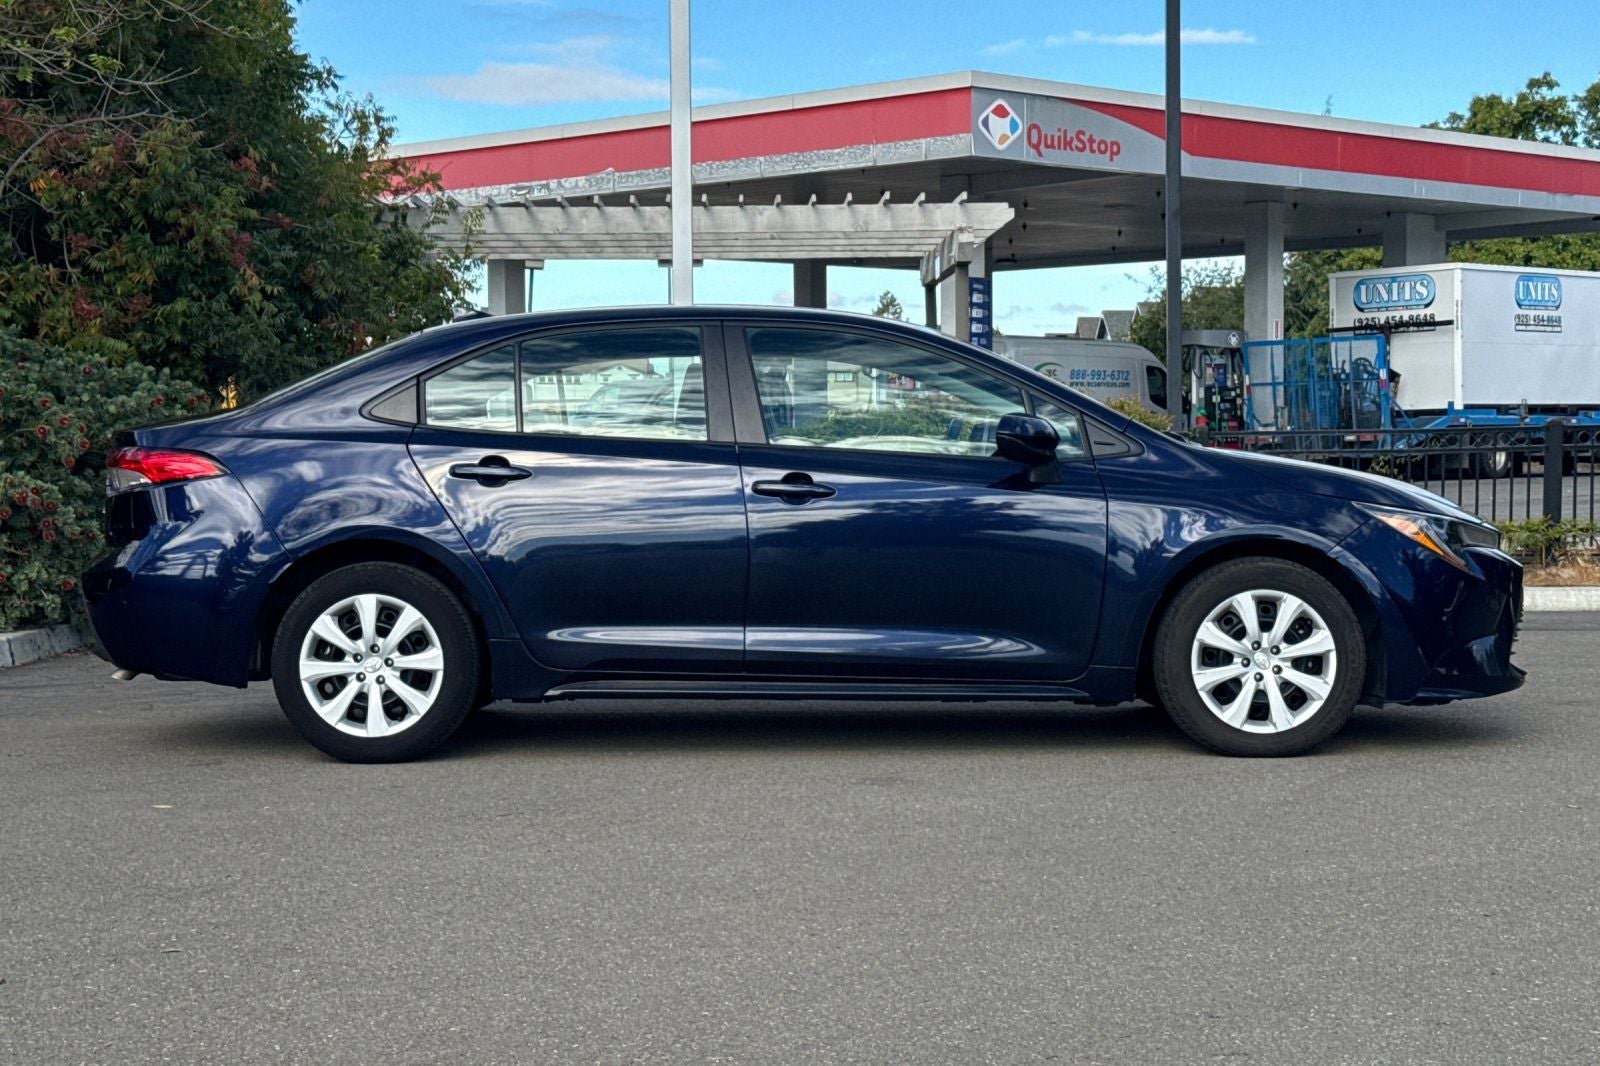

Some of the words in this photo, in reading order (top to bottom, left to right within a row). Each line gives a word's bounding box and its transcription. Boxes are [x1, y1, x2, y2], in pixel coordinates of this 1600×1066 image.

[1026, 122, 1121, 161] QuikStop
[1359, 280, 1429, 305] UNITS
[1518, 281, 1558, 302] UNITS
[1514, 313, 1531, 325] (925)
[1069, 369, 1130, 381] 888-993-6312
